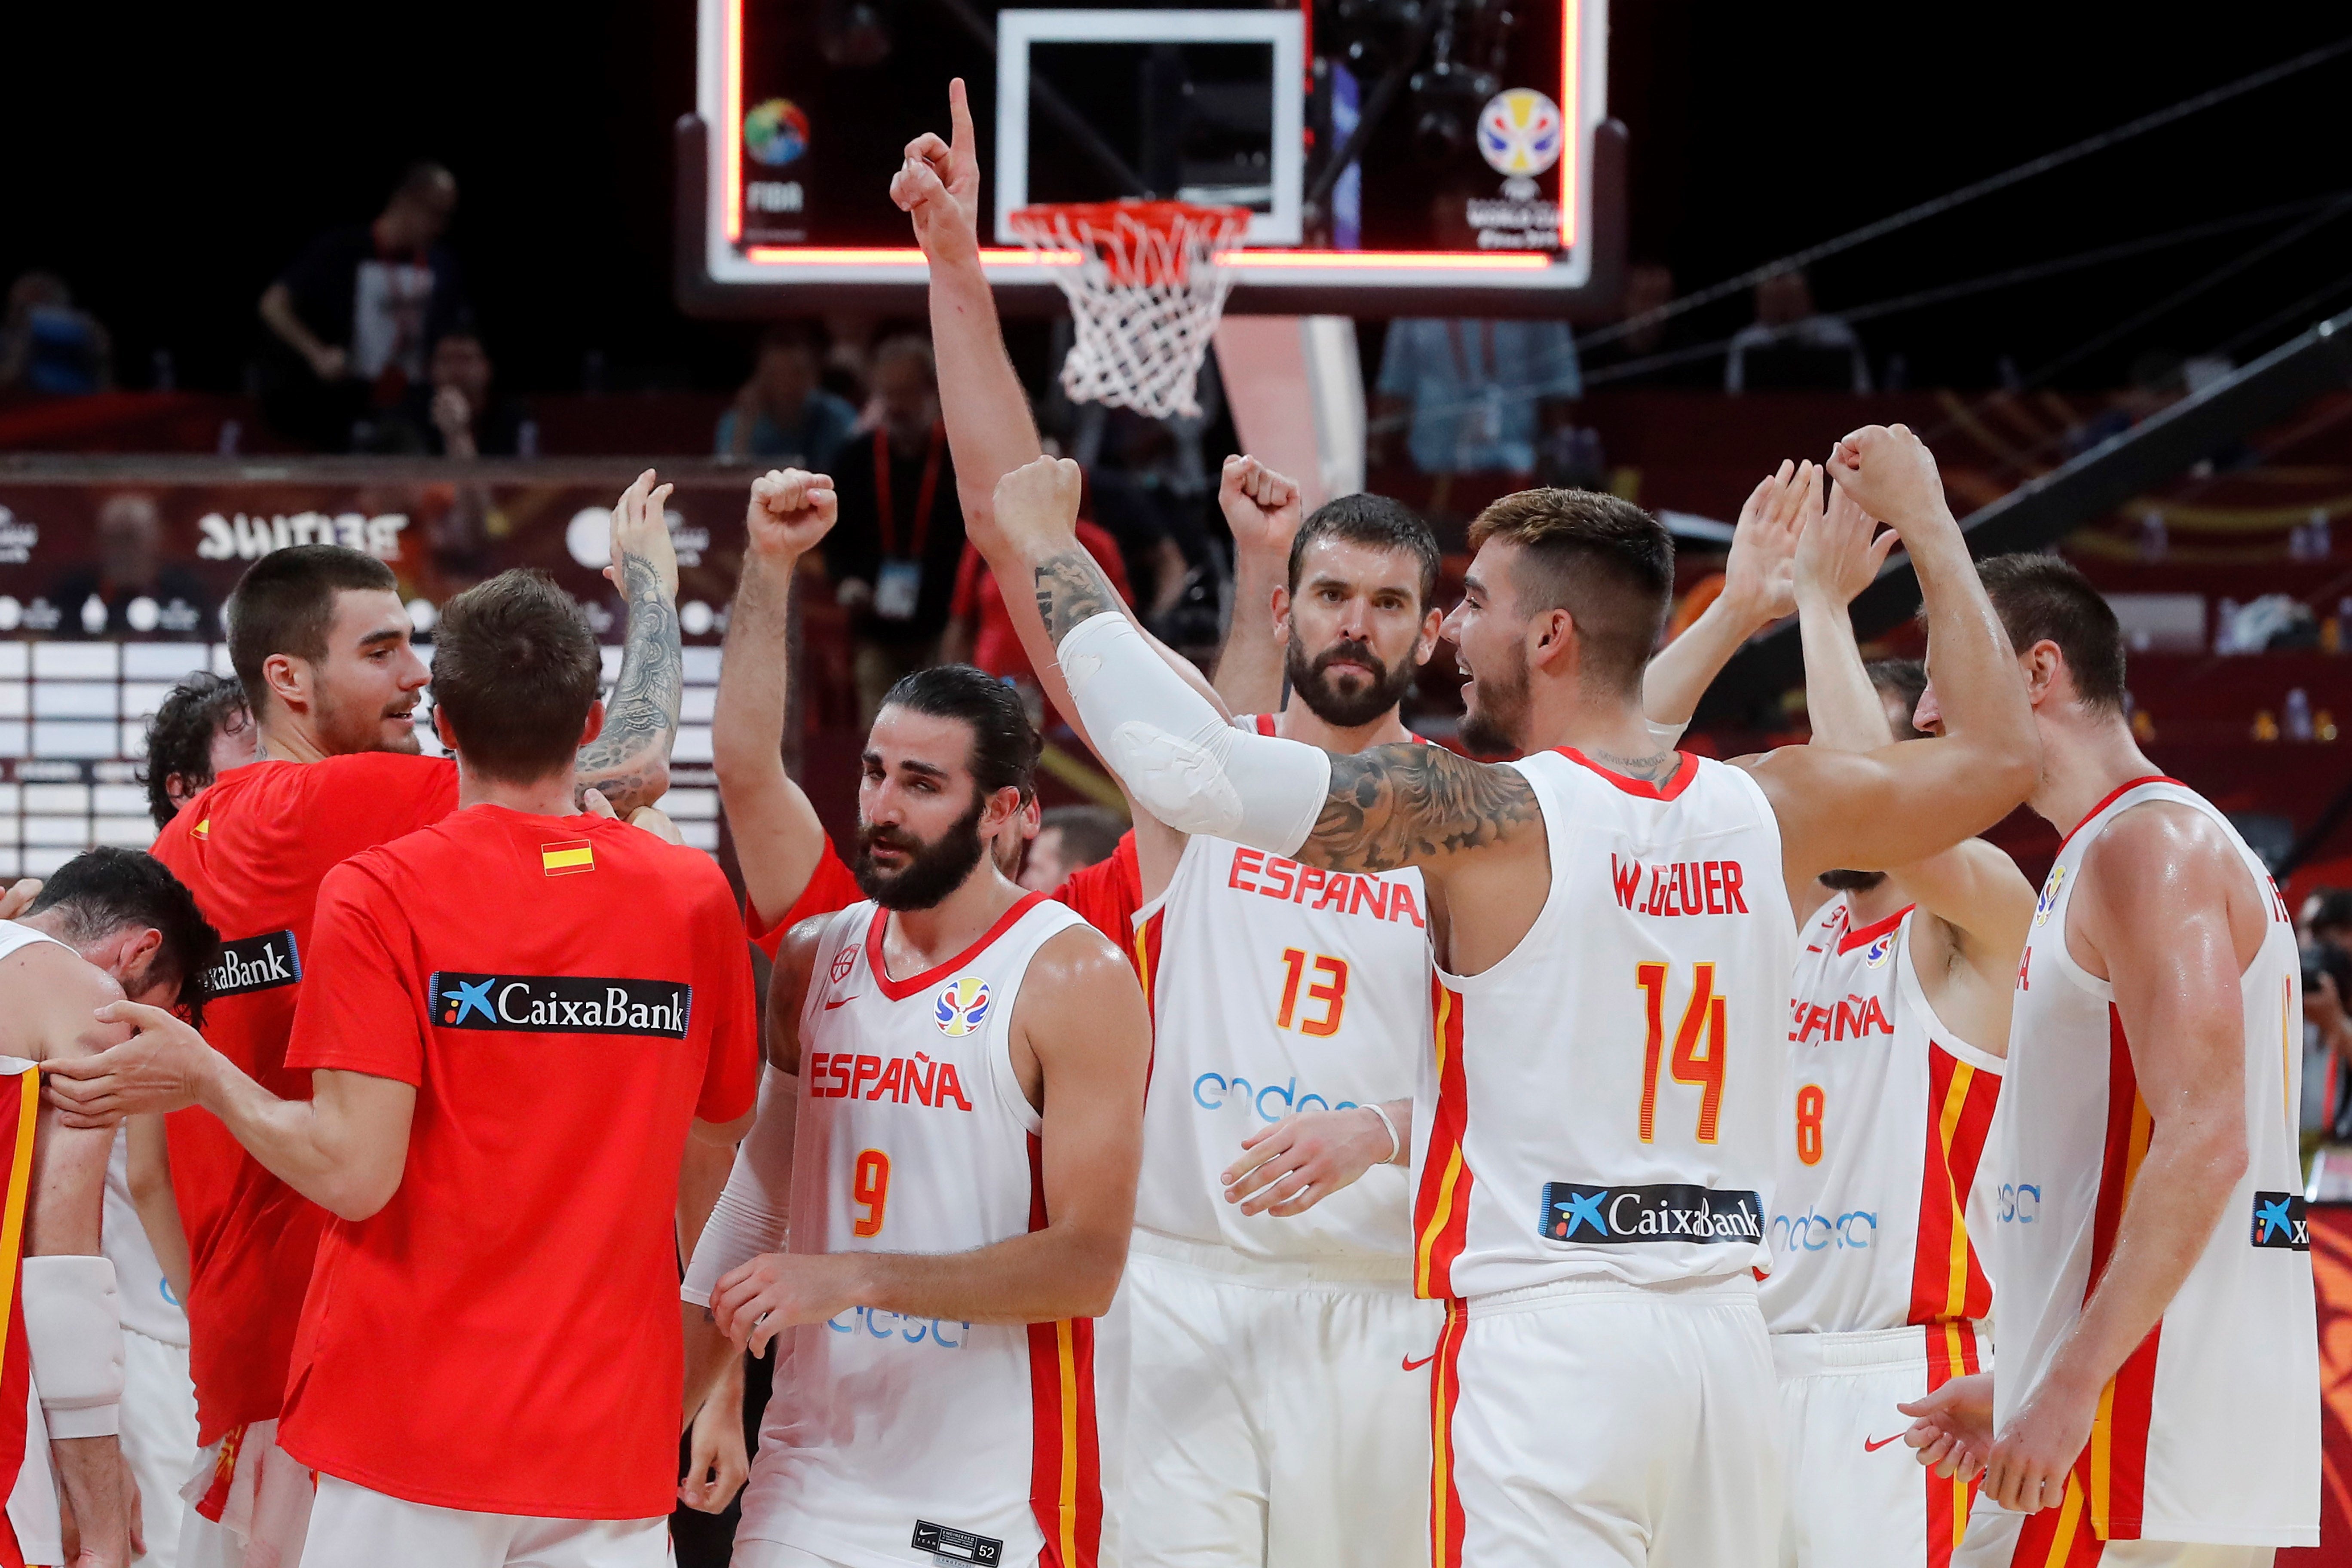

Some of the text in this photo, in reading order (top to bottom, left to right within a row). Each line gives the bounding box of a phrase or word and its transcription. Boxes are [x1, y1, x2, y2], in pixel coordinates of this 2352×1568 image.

[1228, 847, 1424, 928] ESPAÑA
[1611, 853, 1749, 916] W.GEUER
[204, 942, 291, 991] xaBank
[1276, 946, 1350, 1038] 13
[497, 982, 684, 1032] CaixaBank
[811, 1051, 972, 1112] ESPAÑA
[1635, 961, 1727, 1145] 14
[1796, 1083, 1826, 1167] 8
[852, 1148, 891, 1238] 9
[1609, 1193, 1760, 1238] CaixaBank
[917, 1537, 937, 1546] TEAM
[978, 1545, 995, 1559] 52
